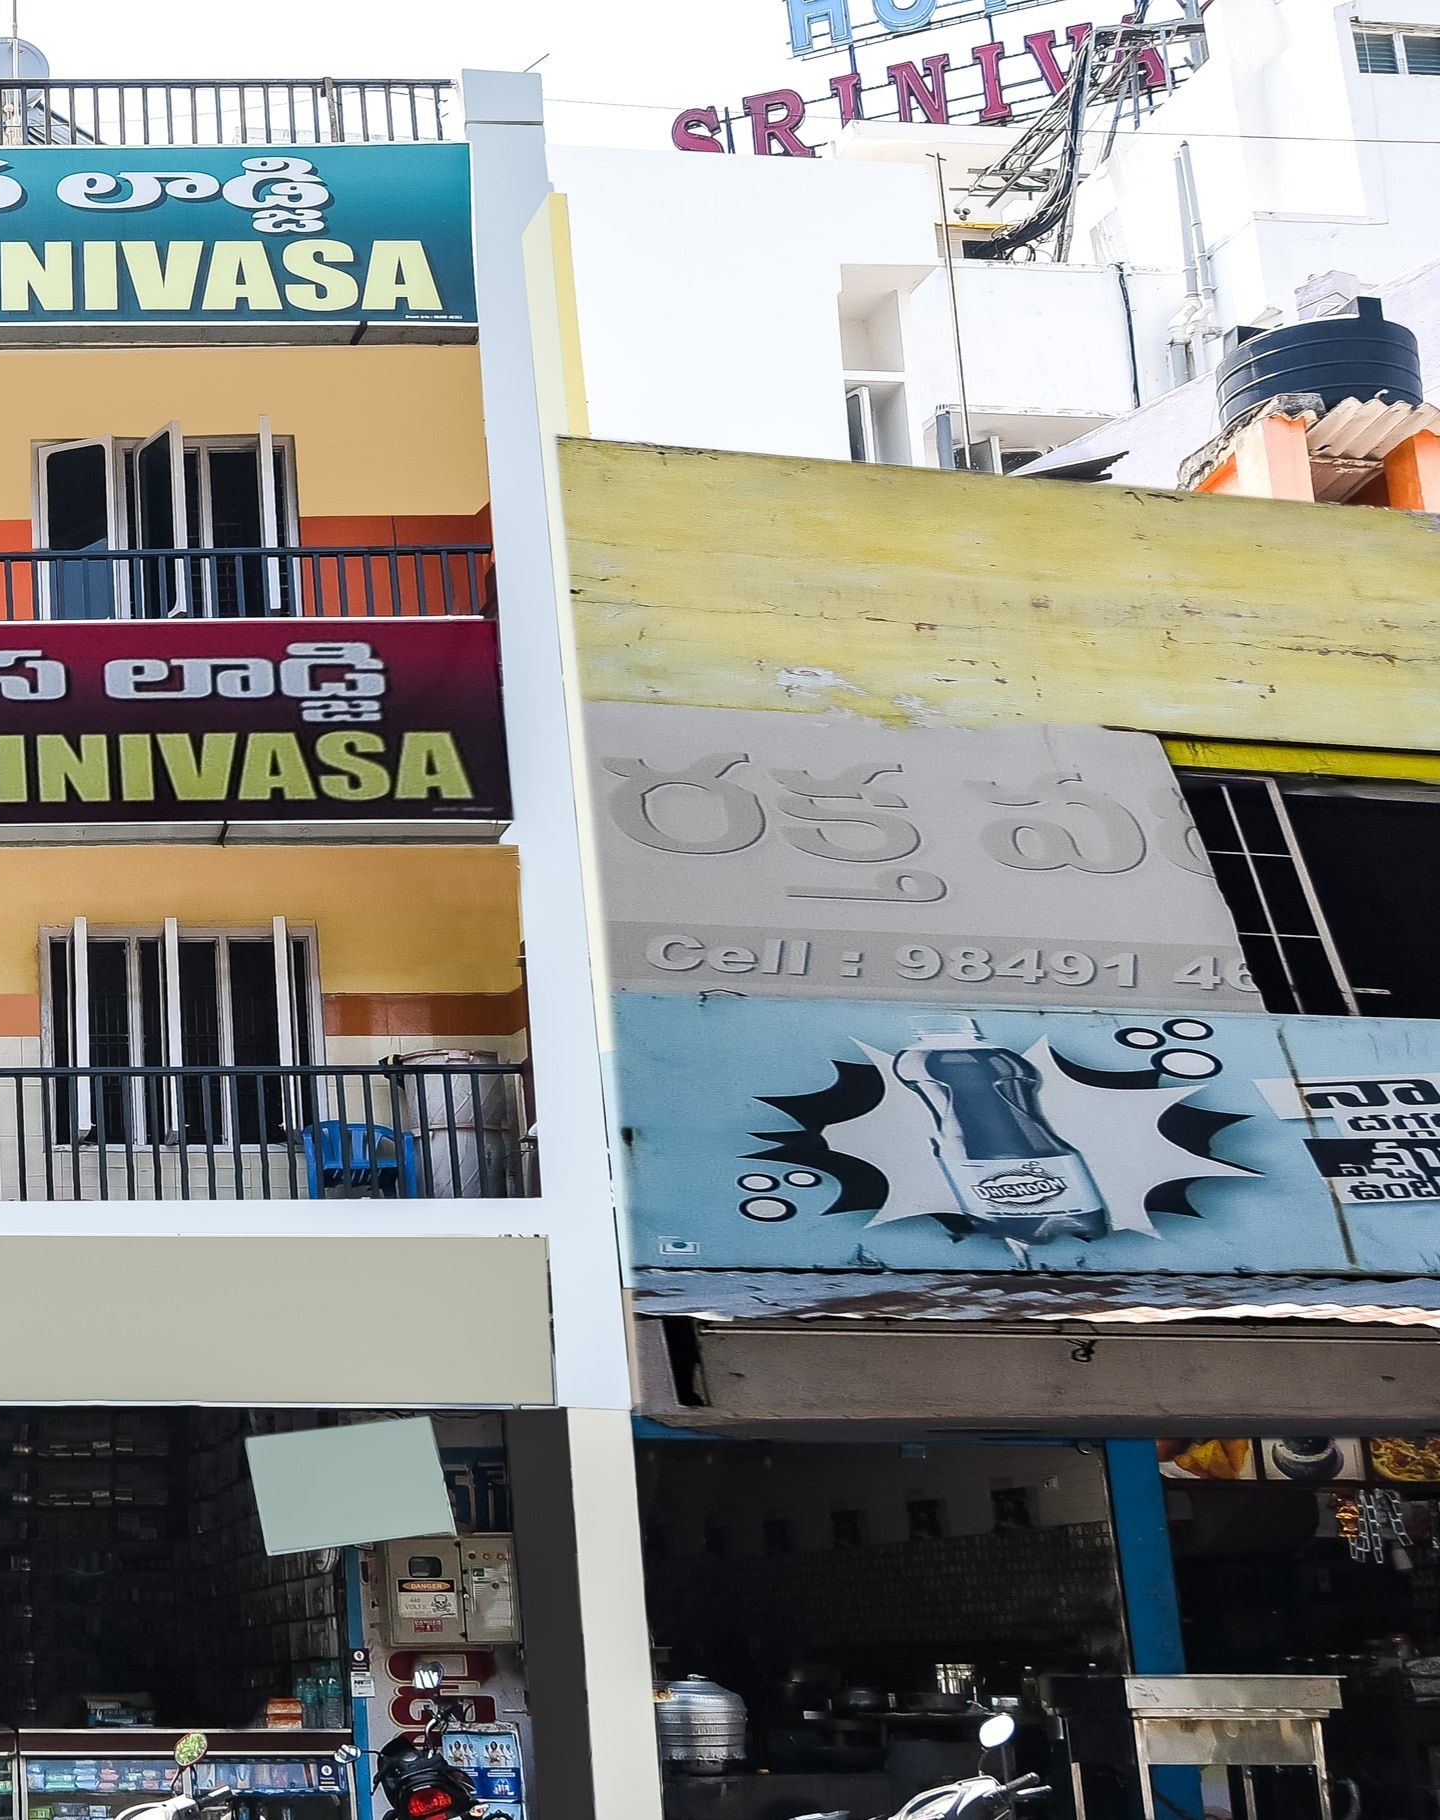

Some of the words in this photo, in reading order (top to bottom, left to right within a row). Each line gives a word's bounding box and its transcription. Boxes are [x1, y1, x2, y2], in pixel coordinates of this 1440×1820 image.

[645, 933, 811, 978] Cell
[895, 943, 1139, 988] 98491
[971, 1176, 1068, 1201] DHISHOOM
